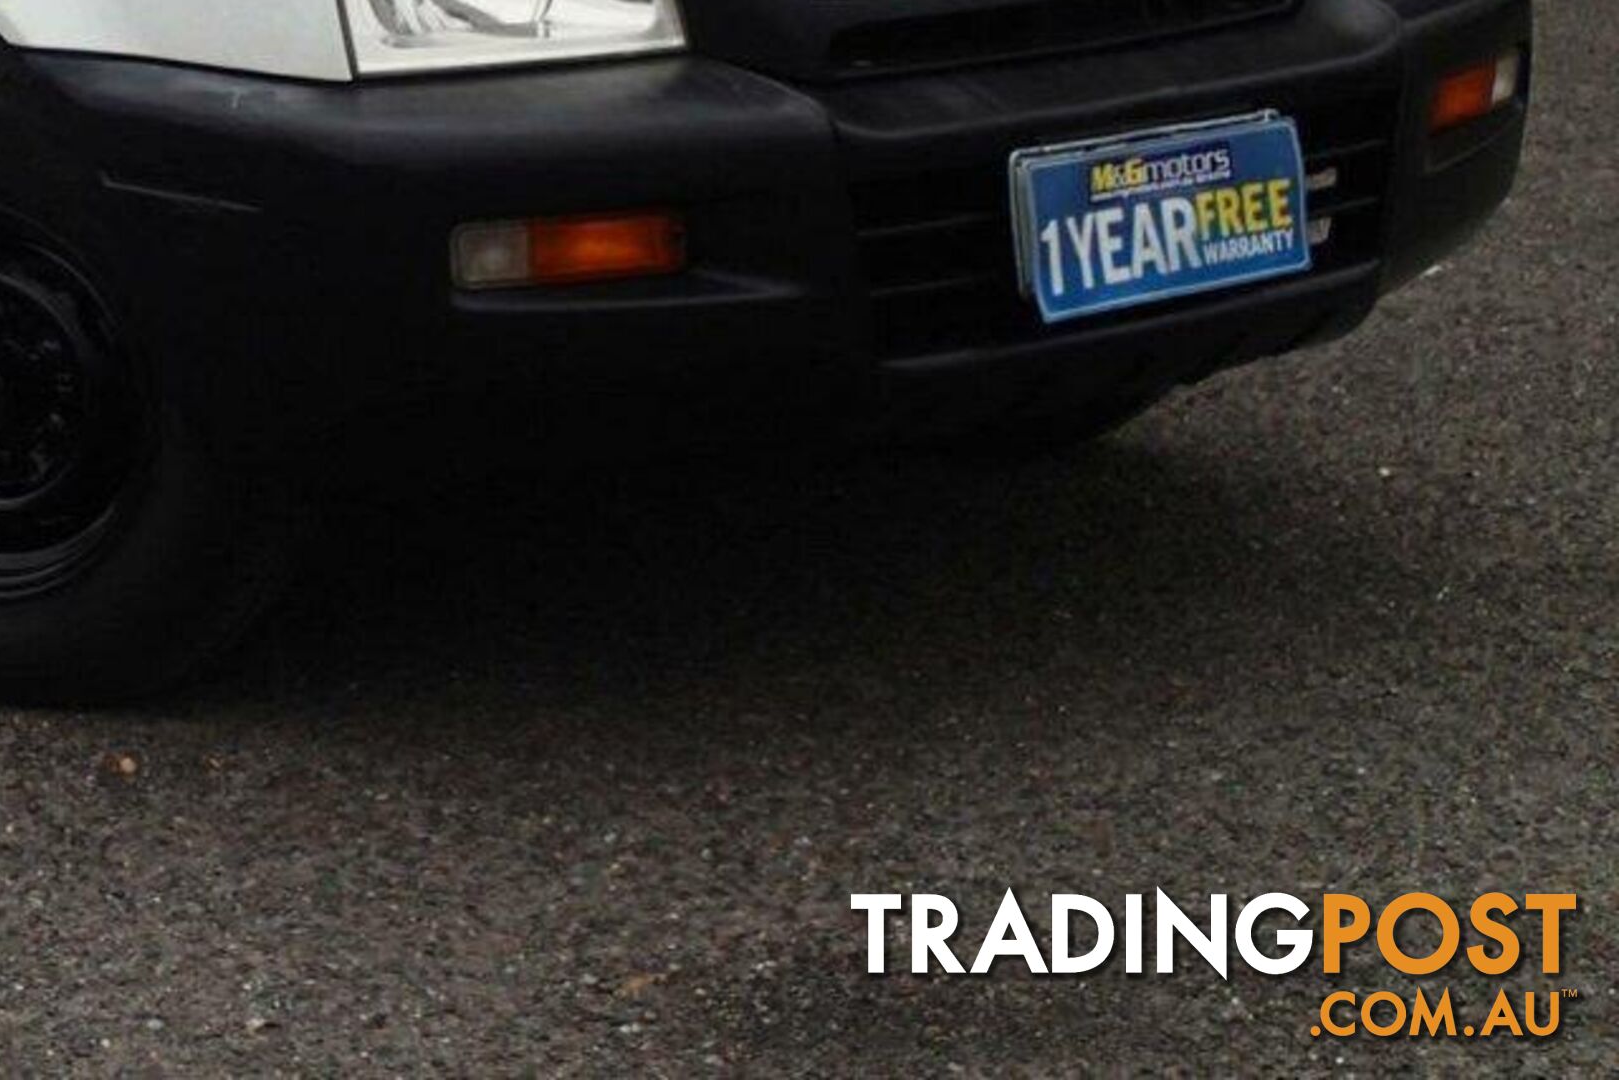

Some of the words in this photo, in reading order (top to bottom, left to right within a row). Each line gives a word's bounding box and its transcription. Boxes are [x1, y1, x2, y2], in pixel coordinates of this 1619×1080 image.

[1040, 220, 1065, 296] 1
[1066, 197, 1203, 289] YEAR
[1195, 178, 1293, 240] FREE
[1203, 228, 1294, 265] WARRANTY
